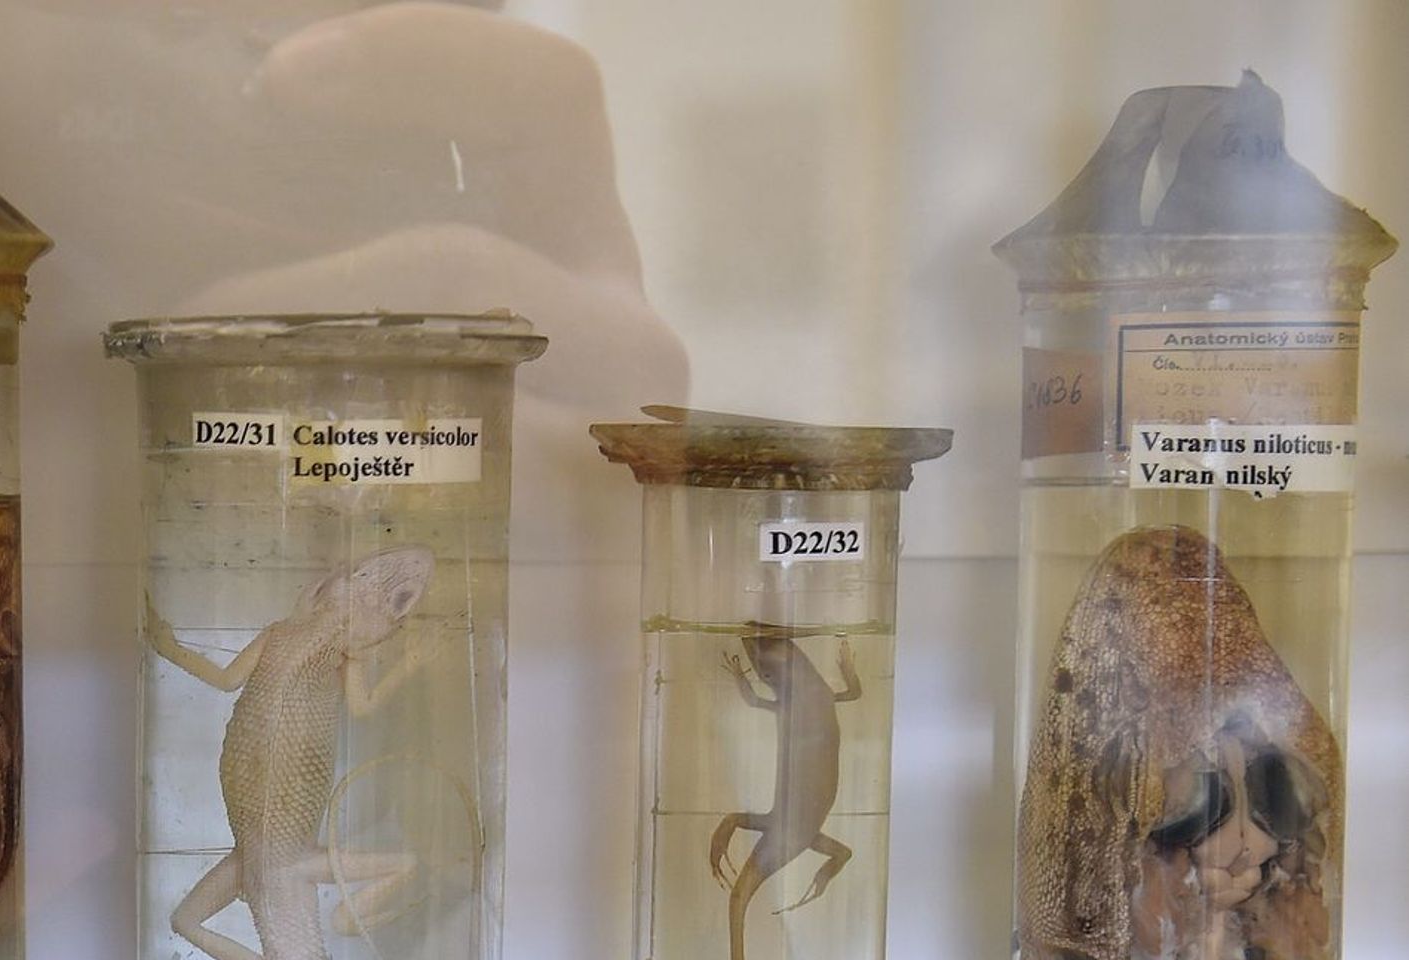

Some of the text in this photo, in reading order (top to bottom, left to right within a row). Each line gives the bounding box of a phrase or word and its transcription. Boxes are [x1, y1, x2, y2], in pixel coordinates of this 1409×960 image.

[1163, 331, 1290, 348] Anatomický
[195, 420, 277, 446] D22/31
[293, 424, 479, 448] Calotes versicolor
[1141, 431, 1246, 453] Varanus
[1253, 433, 1333, 455] niloticus
[293, 456, 415, 482] Lepoještěr
[1140, 463, 1293, 490] Varan nilský
[769, 529, 860, 555] D22/32
